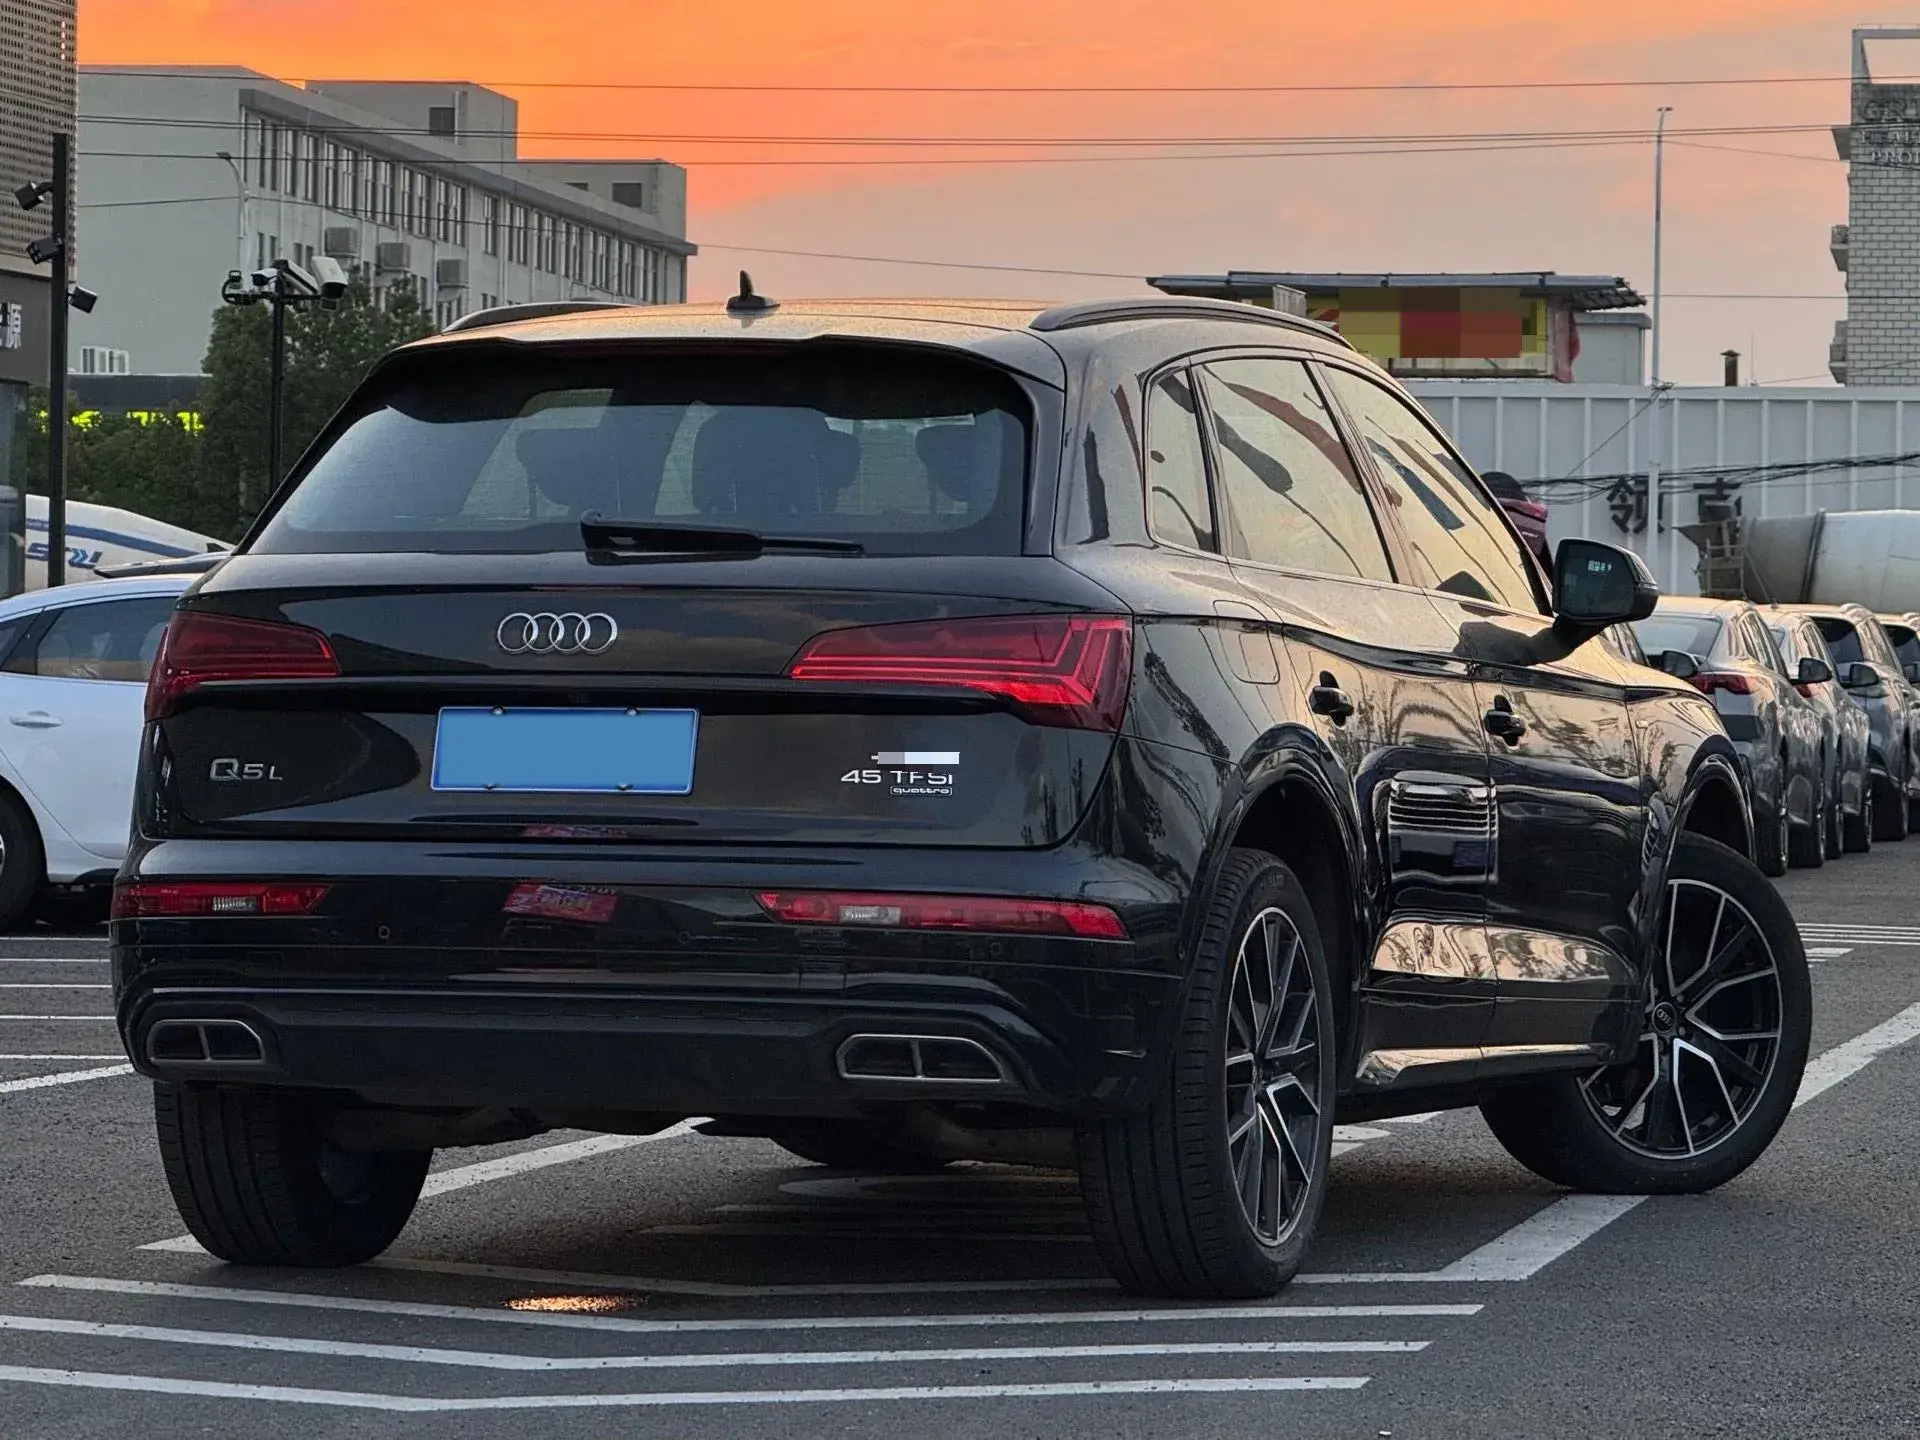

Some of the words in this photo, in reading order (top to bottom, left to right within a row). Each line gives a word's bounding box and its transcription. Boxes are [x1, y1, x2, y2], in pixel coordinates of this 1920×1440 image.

[210, 758, 283, 781] Q5L
[841, 770, 882, 784] 45
[890, 770, 953, 785] TFSI
